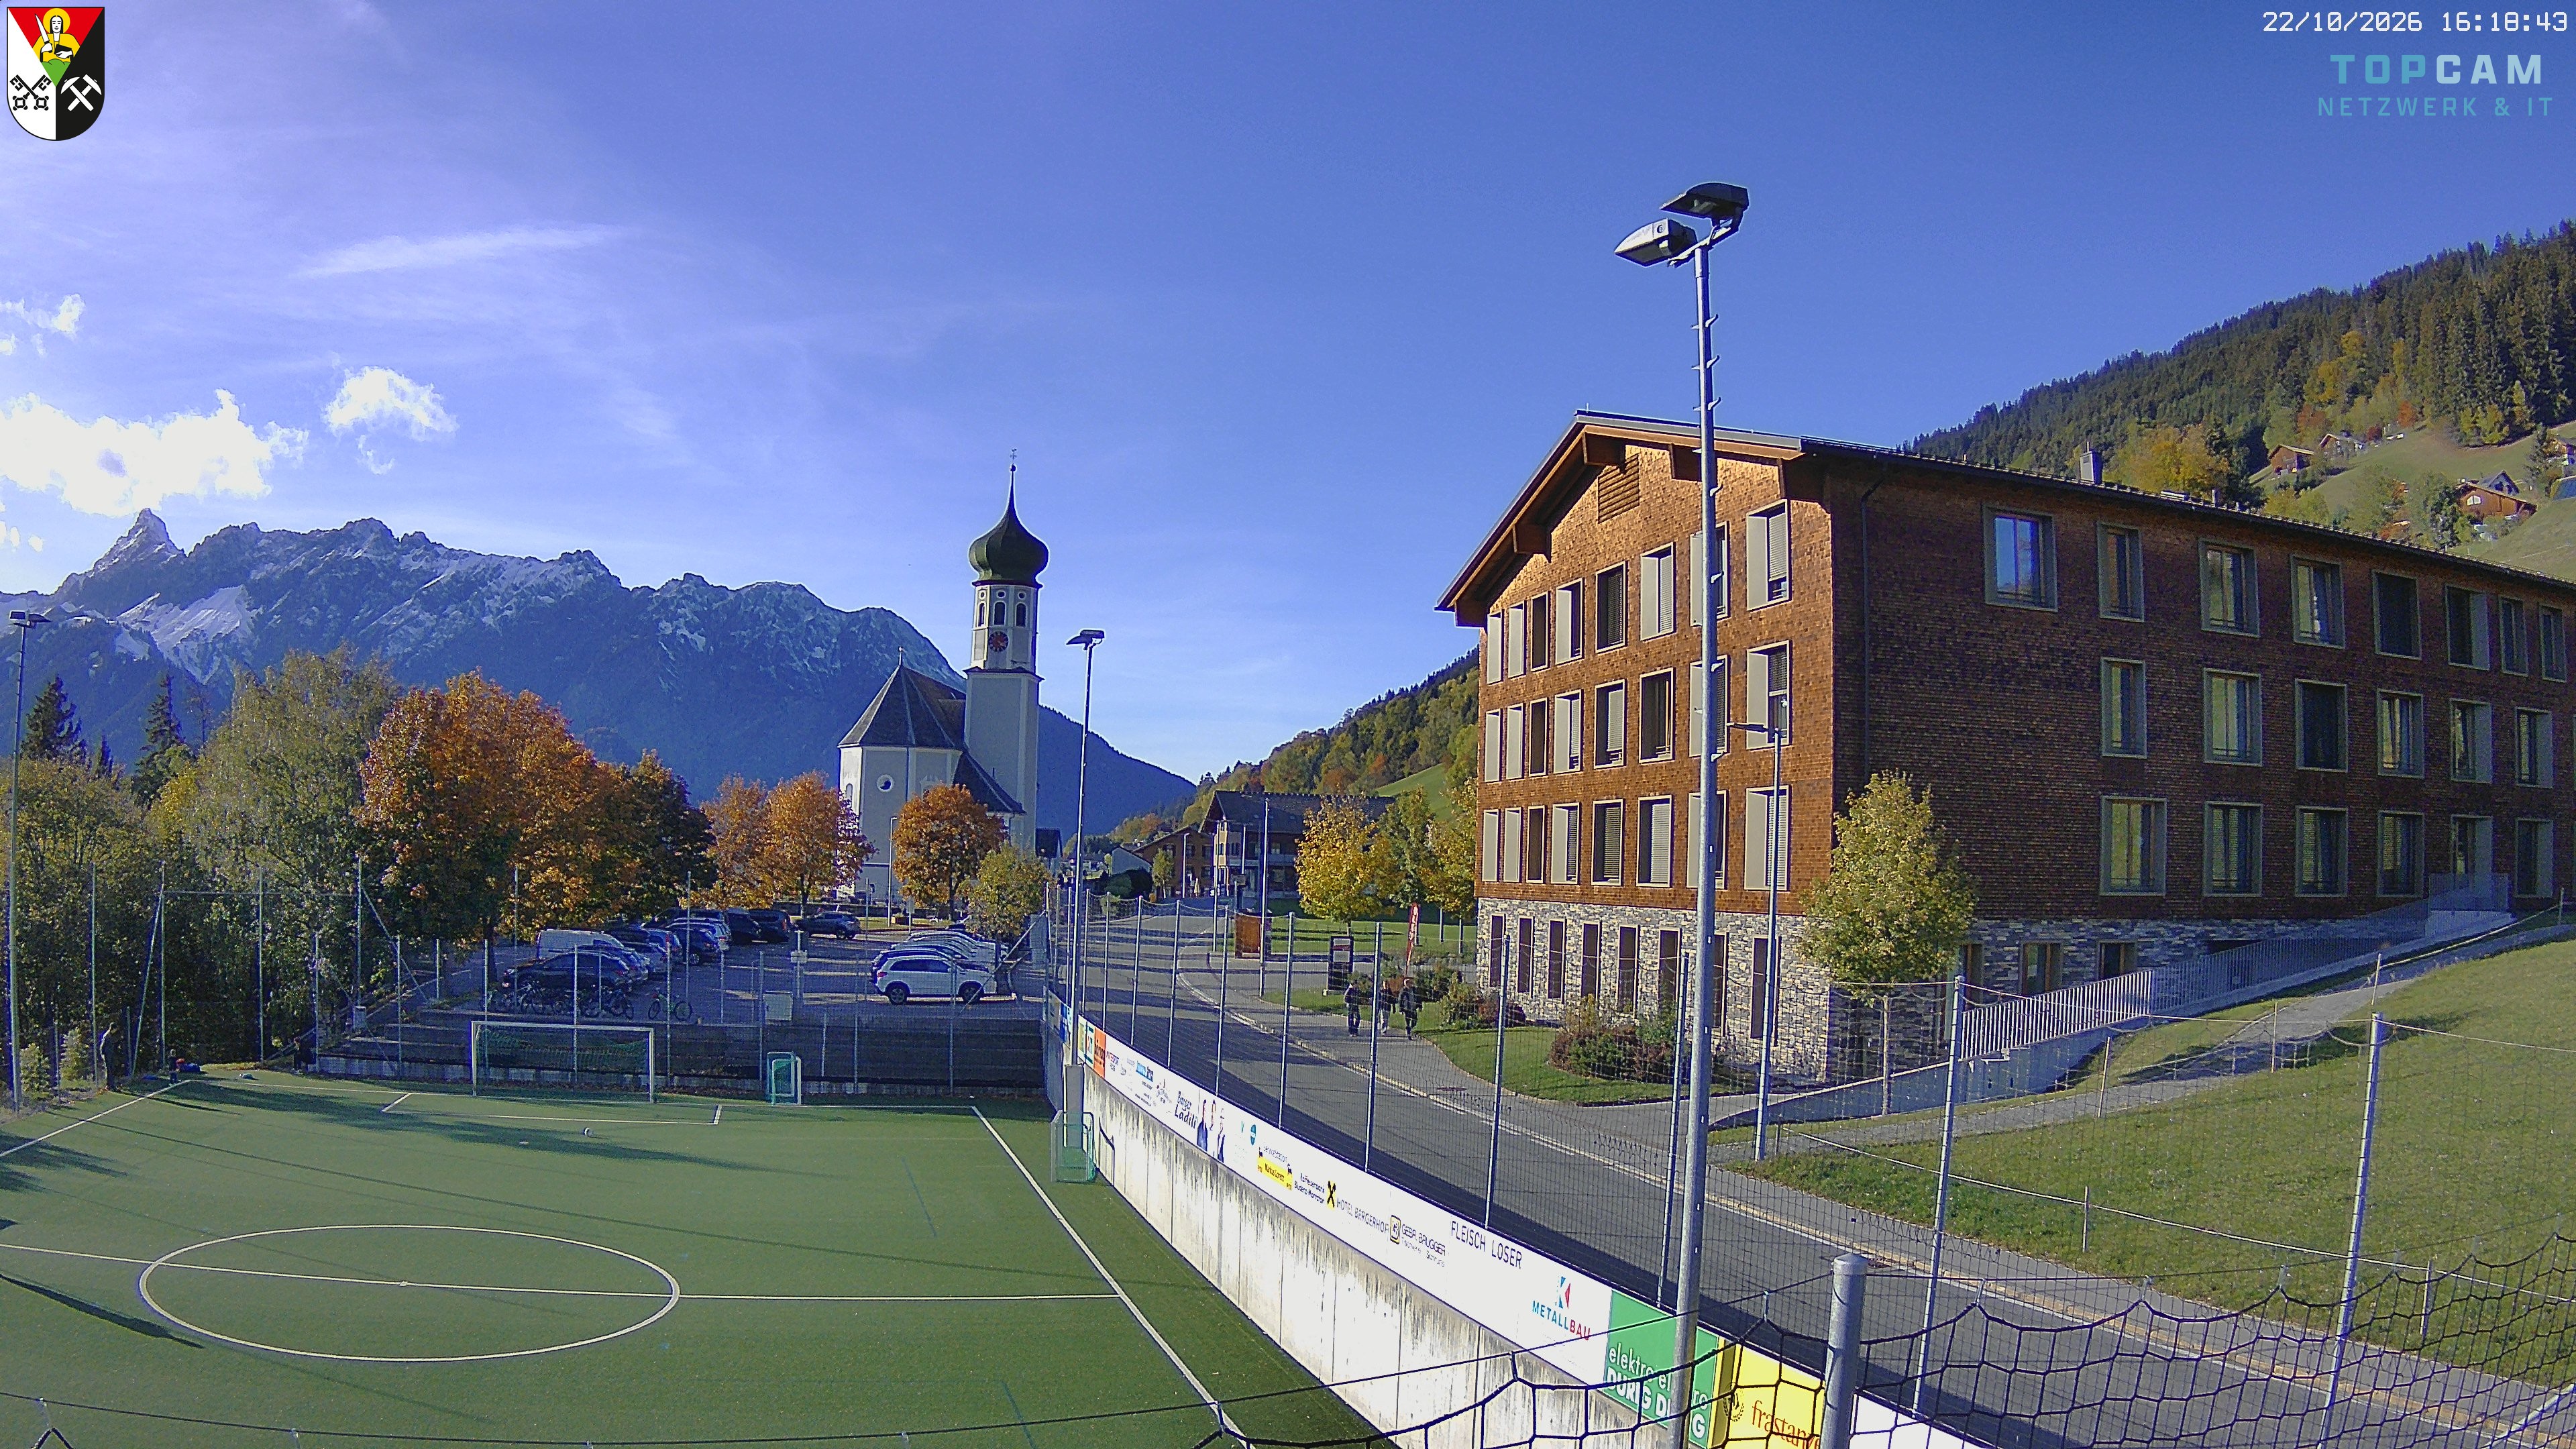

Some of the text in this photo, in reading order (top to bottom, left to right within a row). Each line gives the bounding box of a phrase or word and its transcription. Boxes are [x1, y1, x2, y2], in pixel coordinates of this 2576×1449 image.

[1336, 1197, 1353, 1216] HOTEL
[1451, 1220, 1522, 1269] FLEISCH LOSER
[1532, 1300, 1591, 1340] METALLBAU
[1609, 1342, 1654, 1383] elektro
